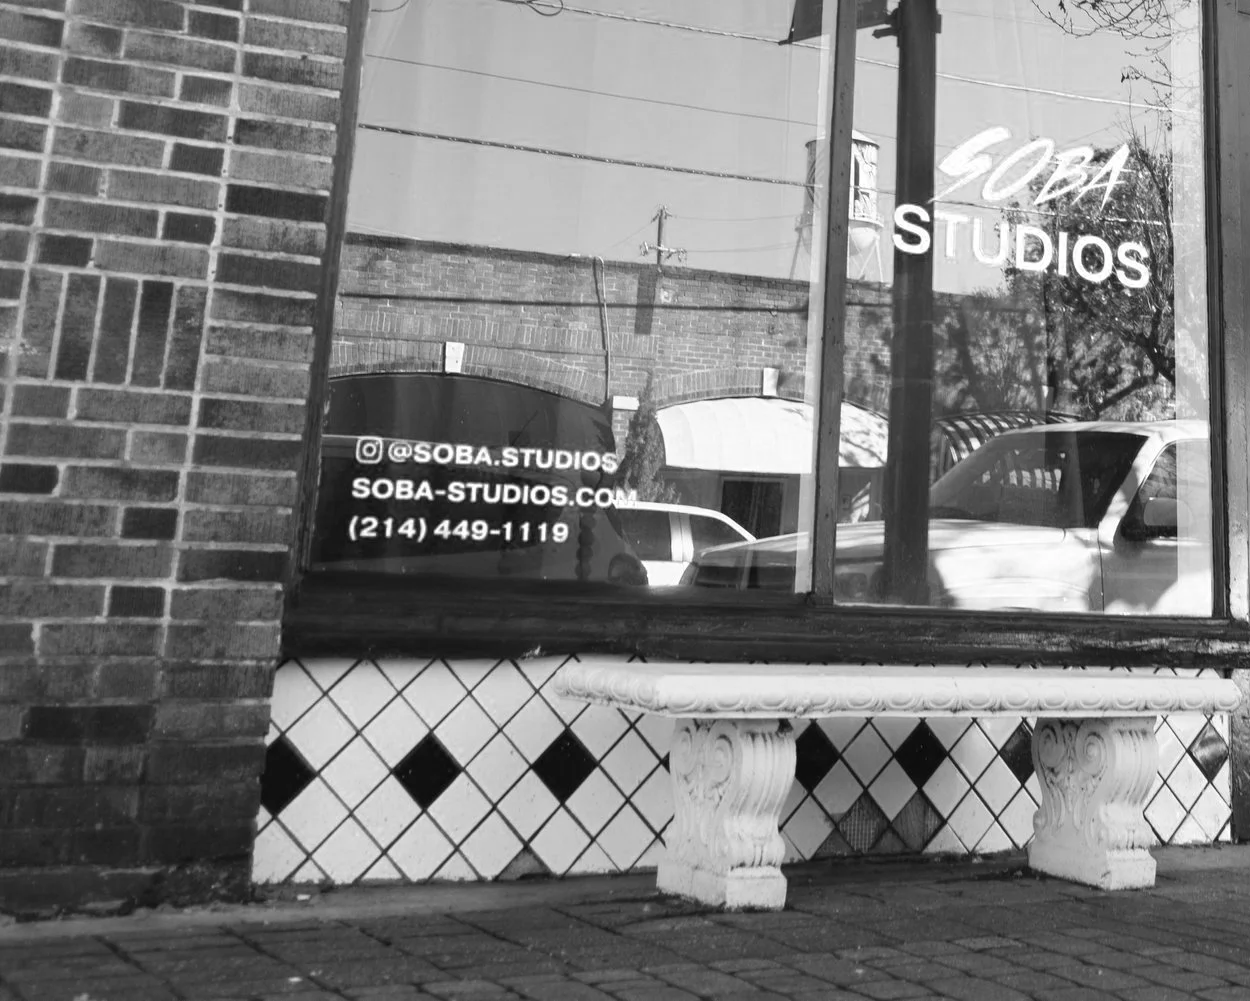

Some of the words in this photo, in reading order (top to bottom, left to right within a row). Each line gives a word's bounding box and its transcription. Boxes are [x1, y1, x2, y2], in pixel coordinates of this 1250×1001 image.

[929, 126, 1130, 210] SOBA
[892, 204, 1151, 289] STUDIOS
[388, 442, 619, 474] @SOBA.STUDIOS
[351, 477, 638, 508] SOBA-STUDIOS.COM
[349, 514, 427, 543] (214)
[434, 519, 569, 543] 449-1119
